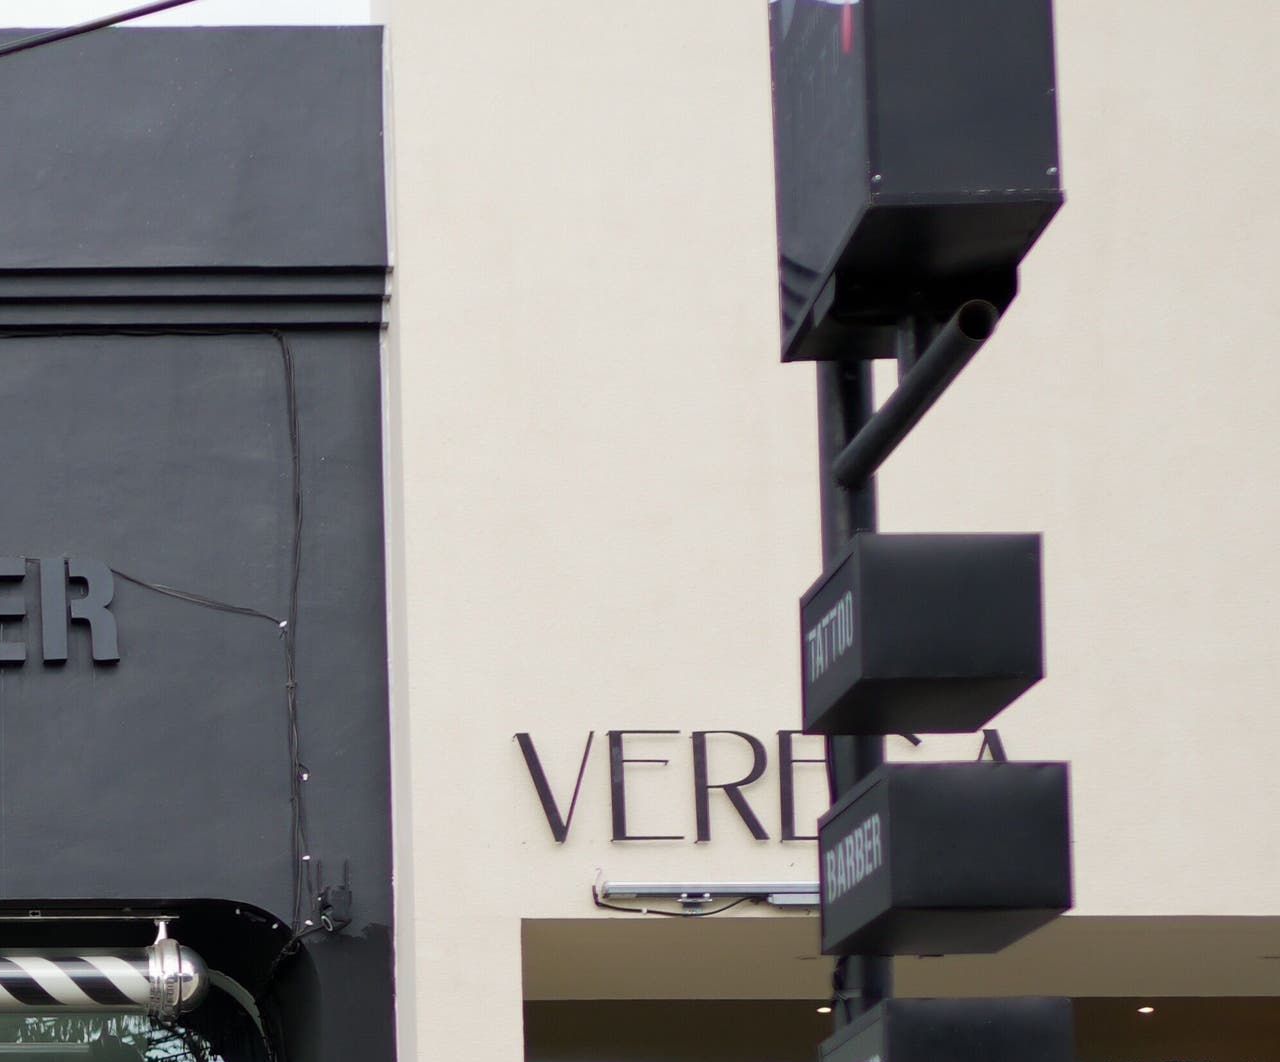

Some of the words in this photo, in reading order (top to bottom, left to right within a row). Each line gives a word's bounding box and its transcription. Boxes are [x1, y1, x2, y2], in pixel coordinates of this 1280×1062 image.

[807, 589, 854, 684] TATTOO
[512, 729, 1008, 843] VERE
[823, 812, 884, 905] BARBER
